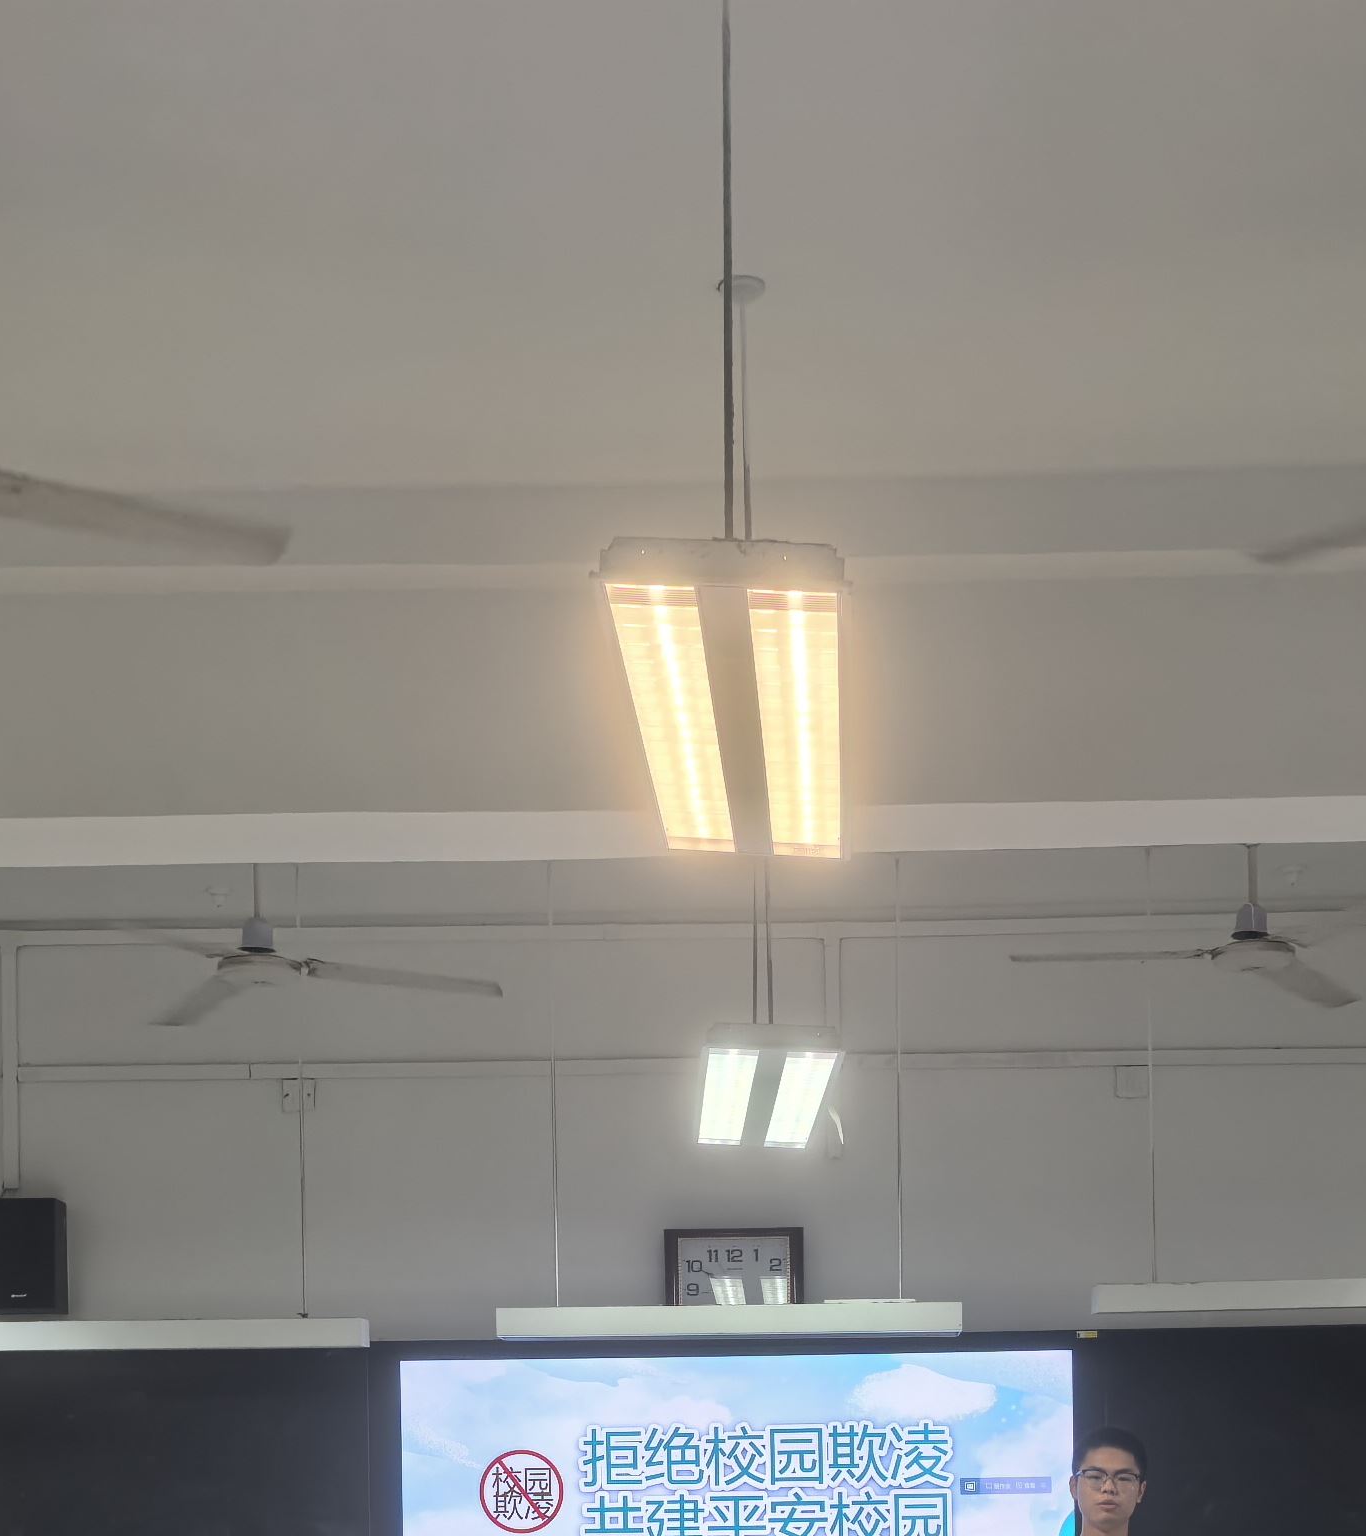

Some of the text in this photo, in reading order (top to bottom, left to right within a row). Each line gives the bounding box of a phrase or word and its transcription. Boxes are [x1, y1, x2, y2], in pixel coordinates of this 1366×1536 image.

[725, 1249, 743, 1262] 12
[686, 1260, 703, 1273] 10
[769, 1258, 782, 1272] 2
[686, 1283, 700, 1296] 9
[582, 1422, 950, 1488] 拒绝校园欺凌
[492, 1467, 552, 1496] 校园
